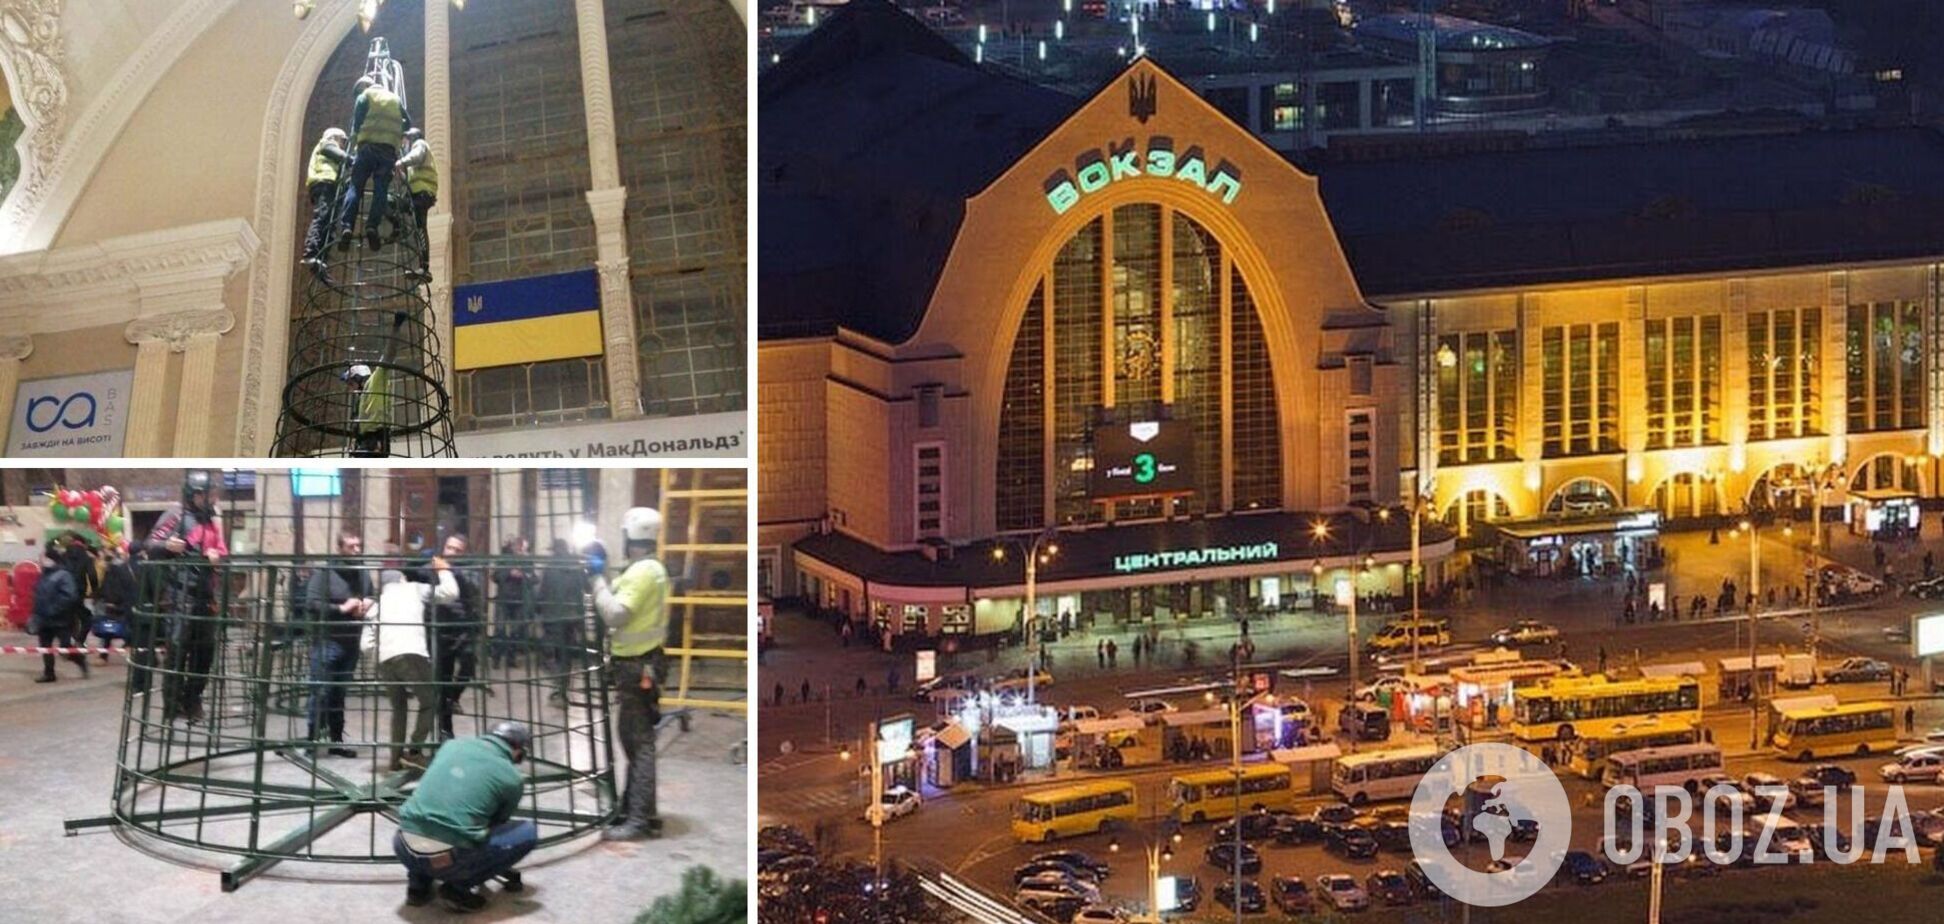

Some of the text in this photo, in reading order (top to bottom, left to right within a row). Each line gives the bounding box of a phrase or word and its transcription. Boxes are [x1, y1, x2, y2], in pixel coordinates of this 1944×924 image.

[1047, 150, 1242, 215] ВОКЗАЛ
[21, 440, 60, 450] ЗАВЖДИ
[62, 438, 75, 447] НА
[1136, 453, 1155, 482] 3
[1114, 541, 1279, 572] ЦЕНТРАЛЬНИЙ
